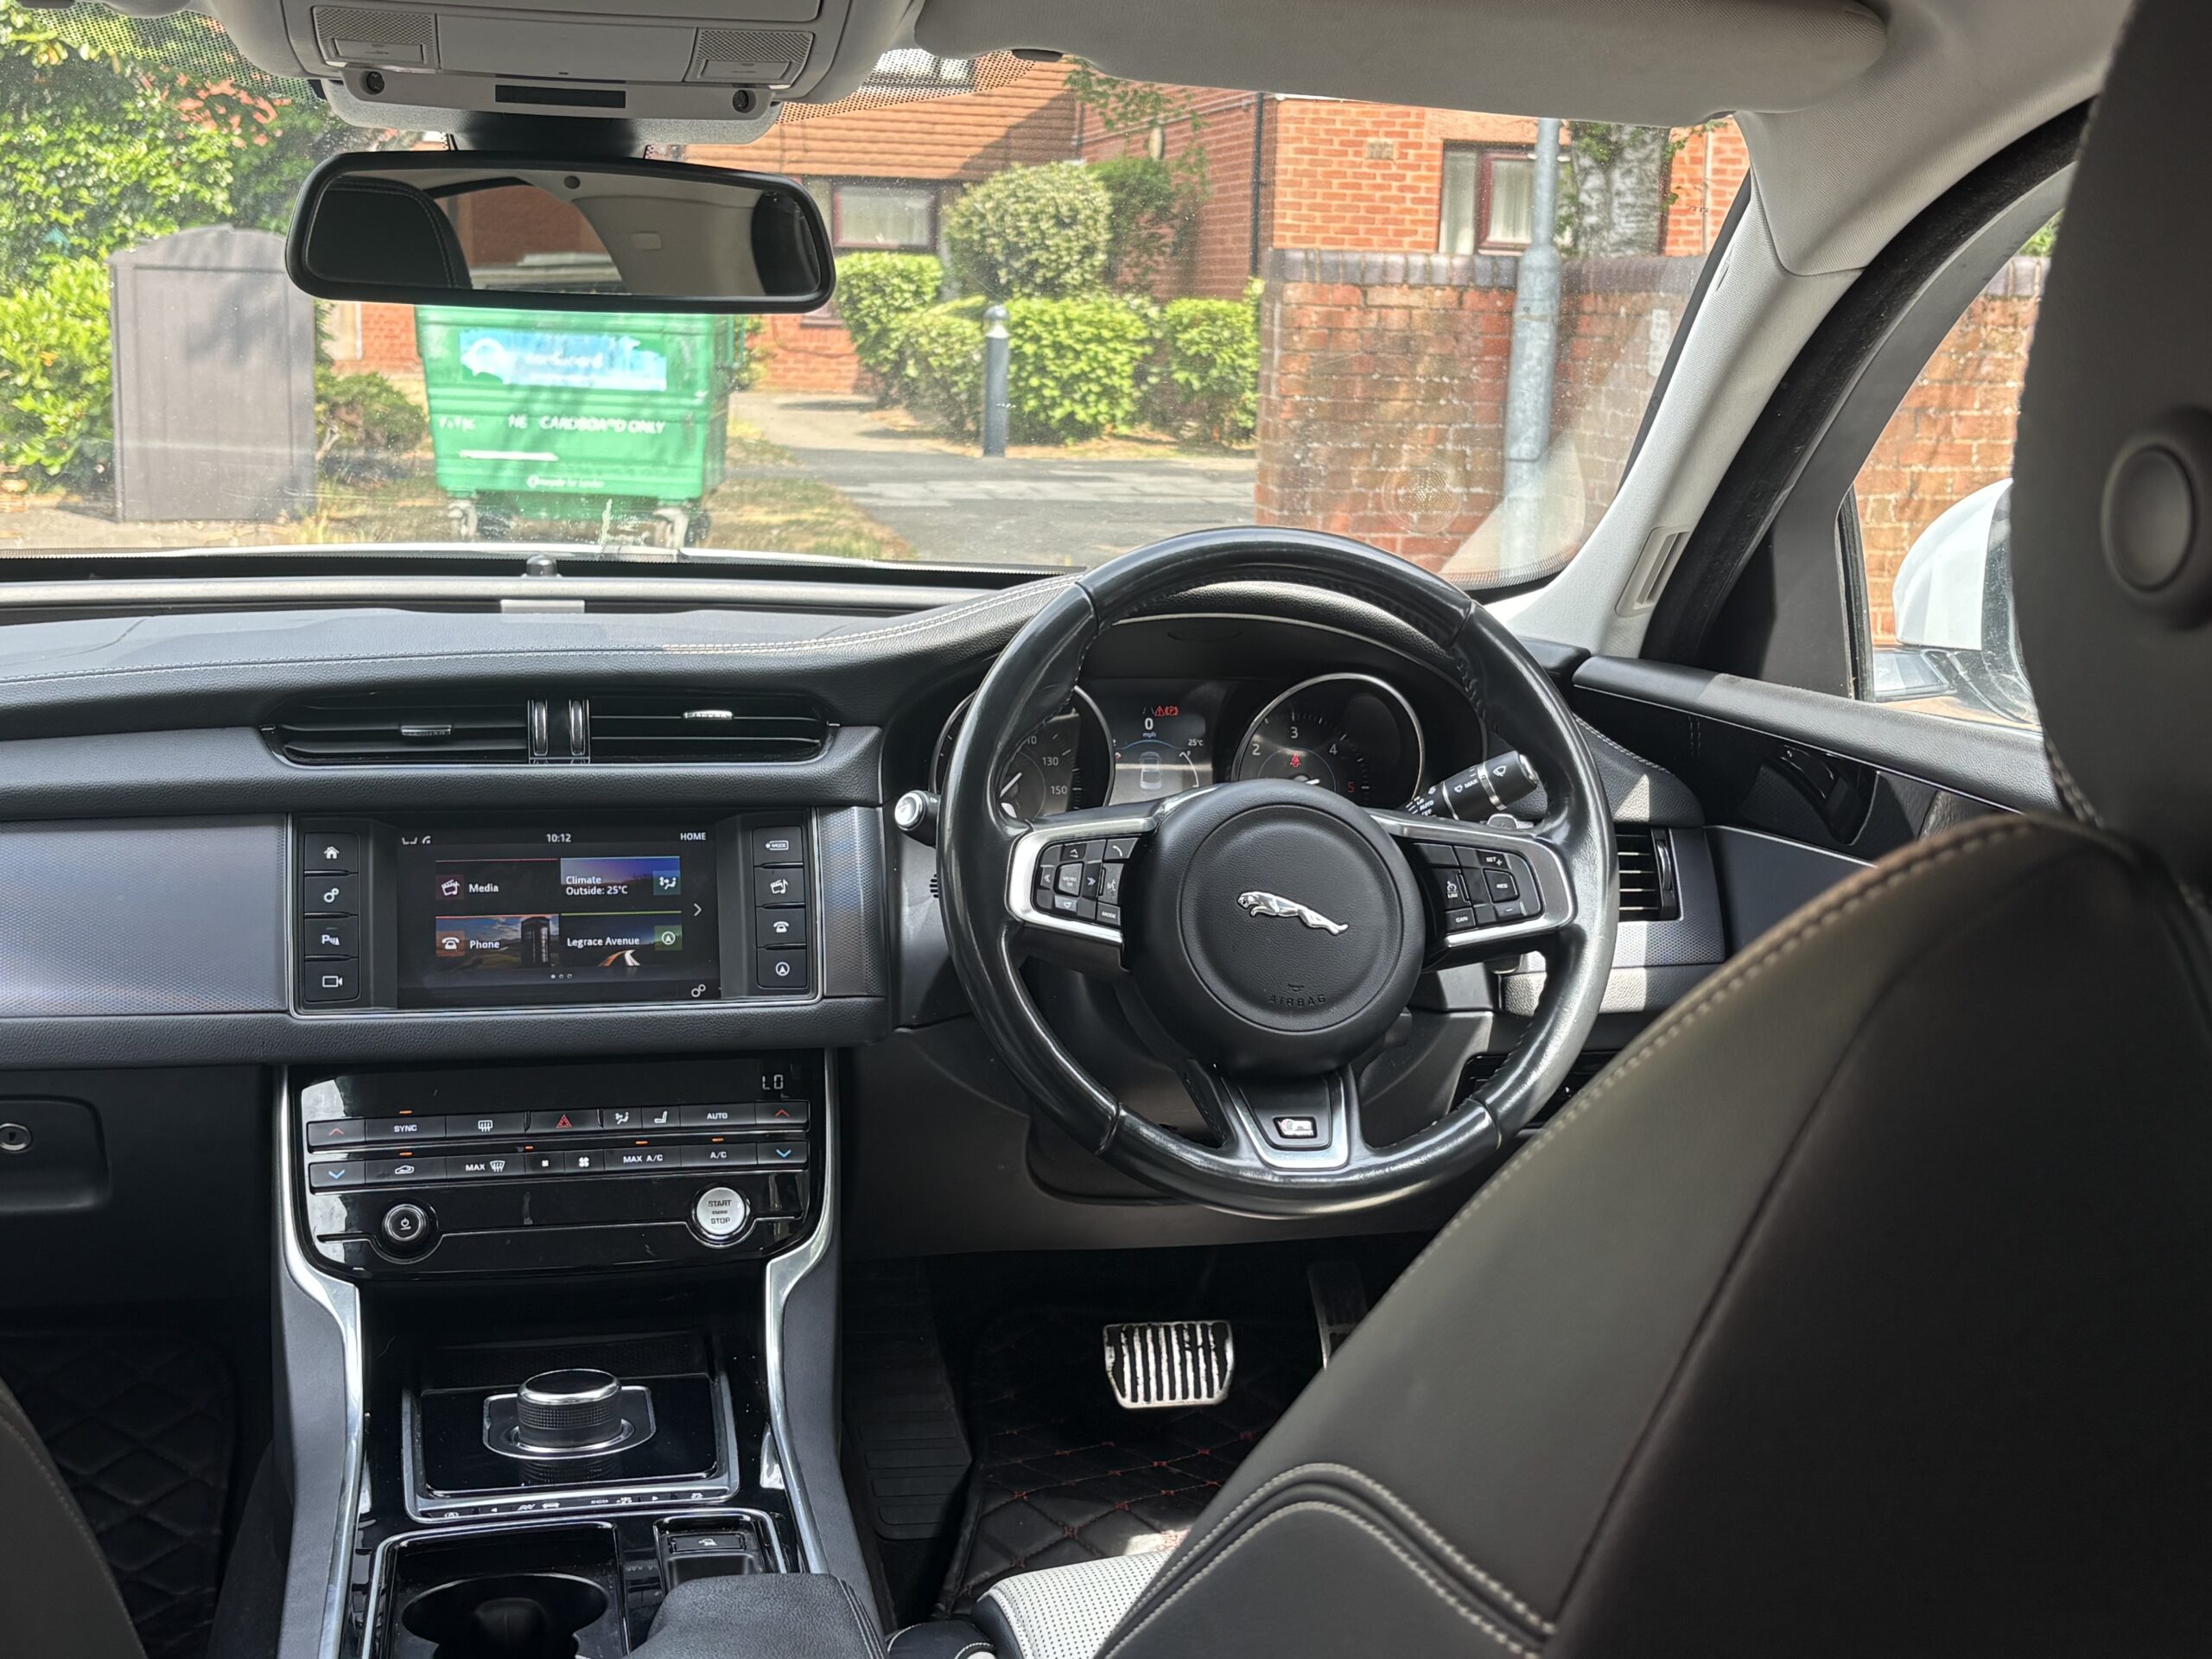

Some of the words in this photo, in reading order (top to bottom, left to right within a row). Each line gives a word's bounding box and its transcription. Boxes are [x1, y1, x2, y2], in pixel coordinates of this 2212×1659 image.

[627, 419, 666, 435] ONLY
[1144, 717, 1154, 731] 0
[1290, 726, 1299, 740] 3
[1252, 743, 1262, 756] 2
[1329, 743, 1338, 756] 4
[1042, 756, 1059, 766] 130
[1347, 781, 1355, 794] 5
[1464, 778, 1479, 789] MAX
[1051, 785, 1068, 795] 150
[546, 833, 572, 842] 10:12
[680, 832, 707, 842] HOME
[566, 875, 602, 885] Climate
[468, 882, 499, 893] Media
[566, 886, 606, 896] Outside:
[607, 885, 628, 895] 25°C
[469, 939, 500, 950] Phone
[567, 938, 603, 949] Legrace
[605, 936, 639, 946] Avenue
[1269, 994, 1326, 1007] AIRBAG
[393, 1124, 417, 1133] SYNC
[623, 1154, 643, 1164] MAX
[646, 1154, 664, 1162] A/C
[709, 1151, 728, 1160] A/C
[465, 1163, 486, 1172] MAX
